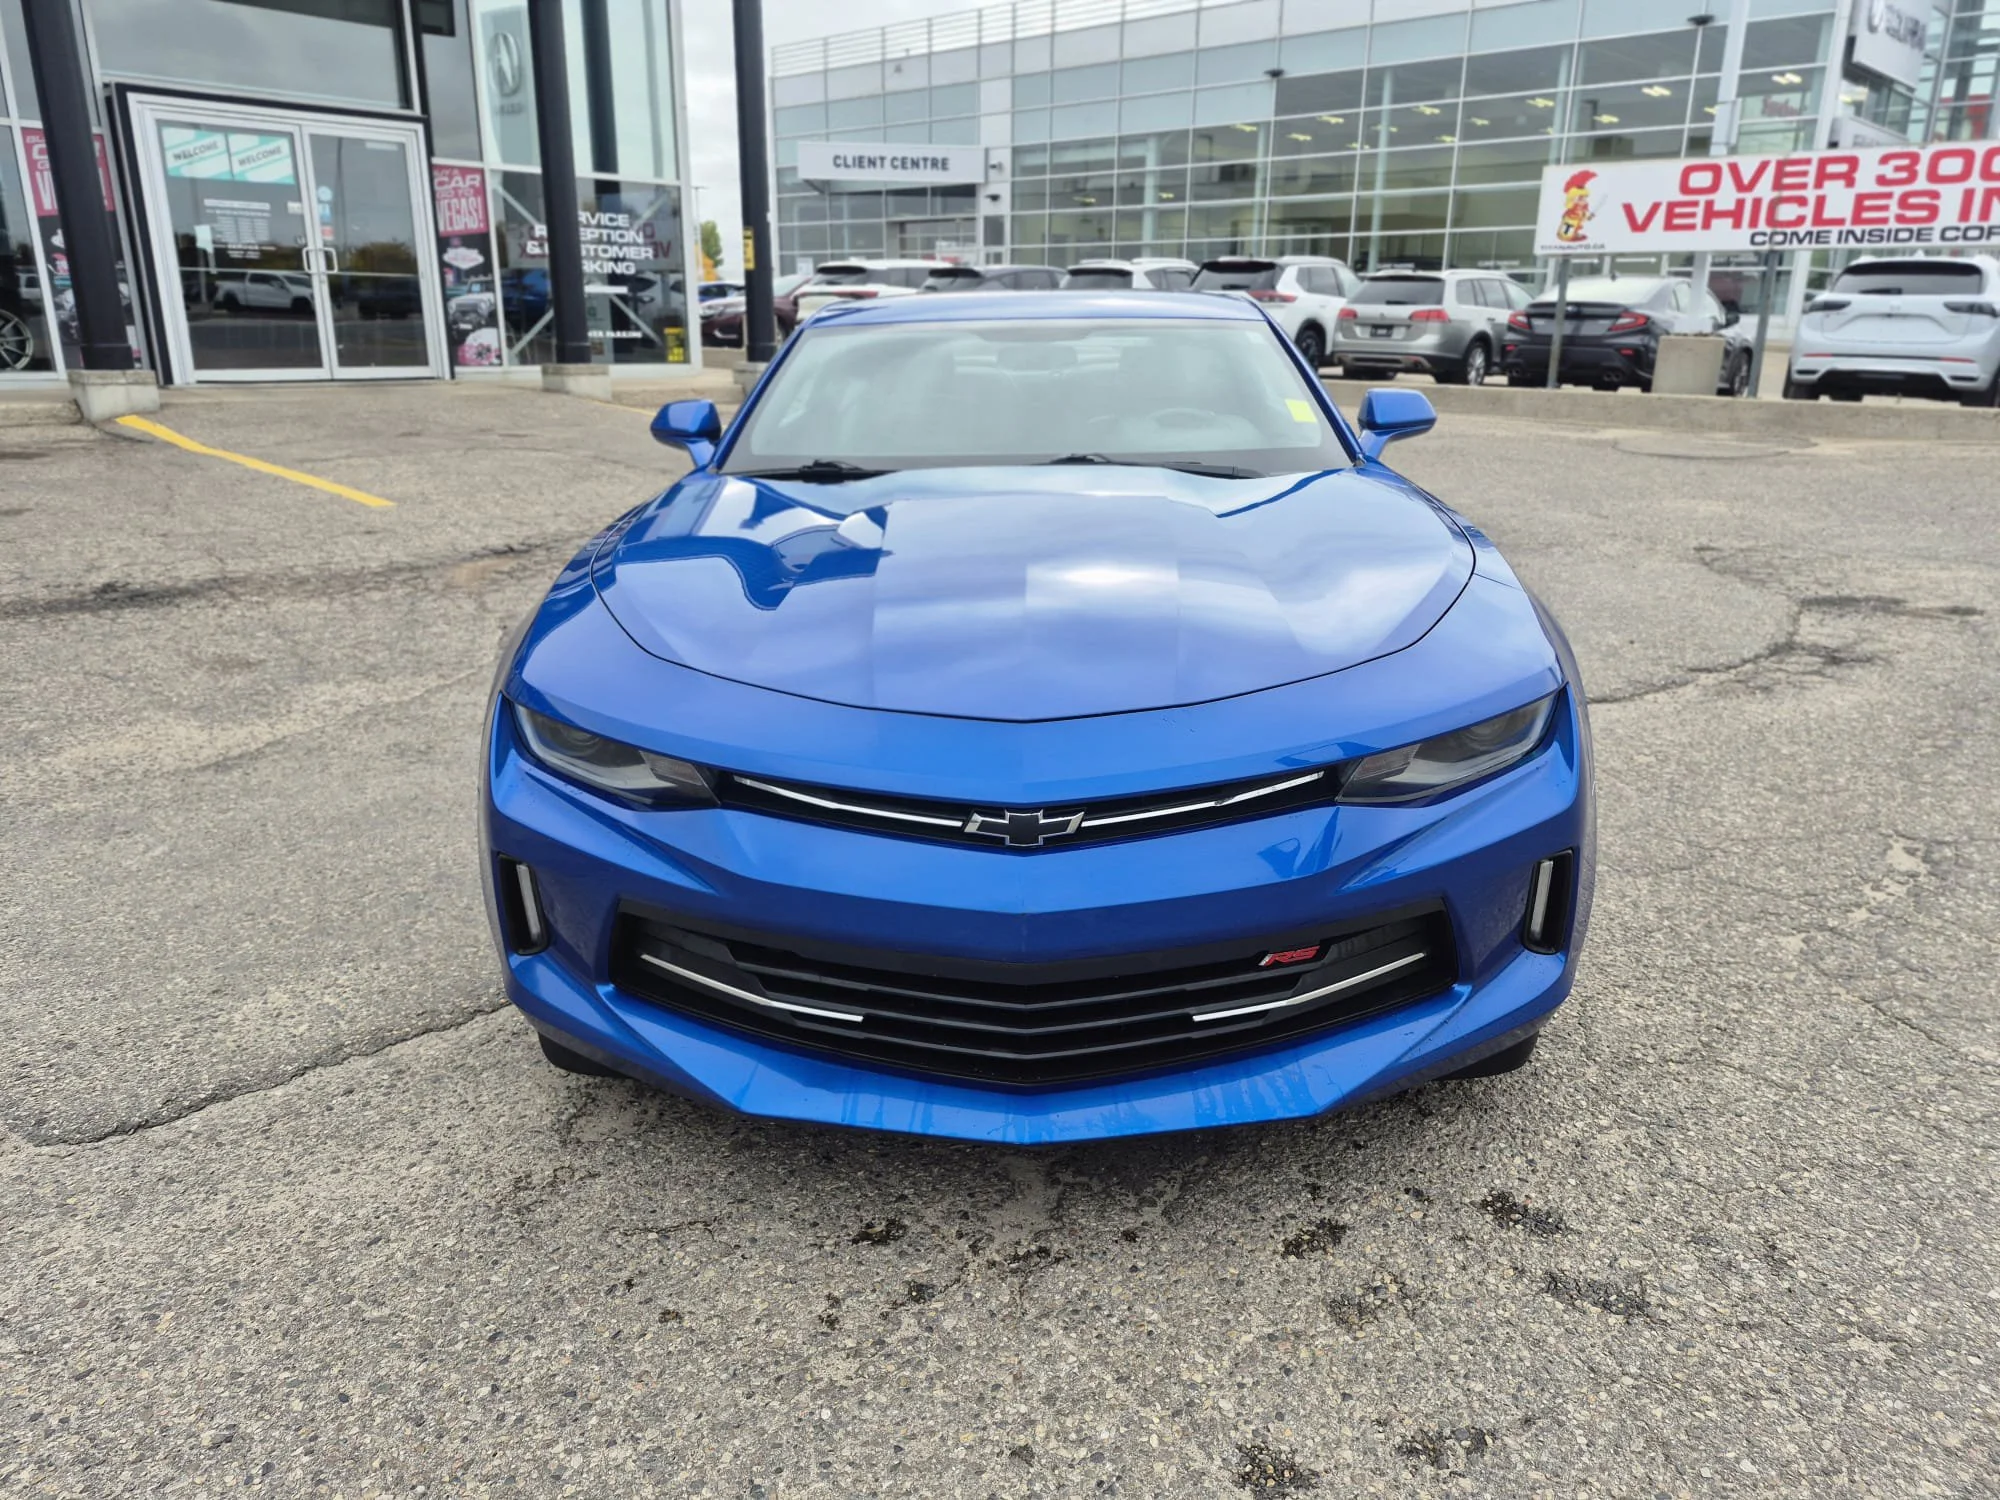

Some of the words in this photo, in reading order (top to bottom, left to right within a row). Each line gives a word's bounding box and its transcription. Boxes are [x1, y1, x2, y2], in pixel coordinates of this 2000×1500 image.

[173, 140, 219, 162] WELCOME
[238, 145, 282, 167] WELCOME
[833, 155, 886, 169] CLIENT
[890, 157, 949, 171] CENTRE
[434, 174, 481, 190] CAR
[1679, 155, 1859, 195] OVER
[435, 197, 485, 231] VEGAS!
[578, 211, 630, 227] RVICE
[1622, 189, 1942, 233] VEHICLES
[534, 223, 644, 244] REPTION
[1750, 230, 1832, 246] COME
[1836, 227, 1934, 244] INSIDE
[526, 241, 541, 254] &
[581, 260, 636, 275] RKING
[1264, 945, 1321, 967] RS
